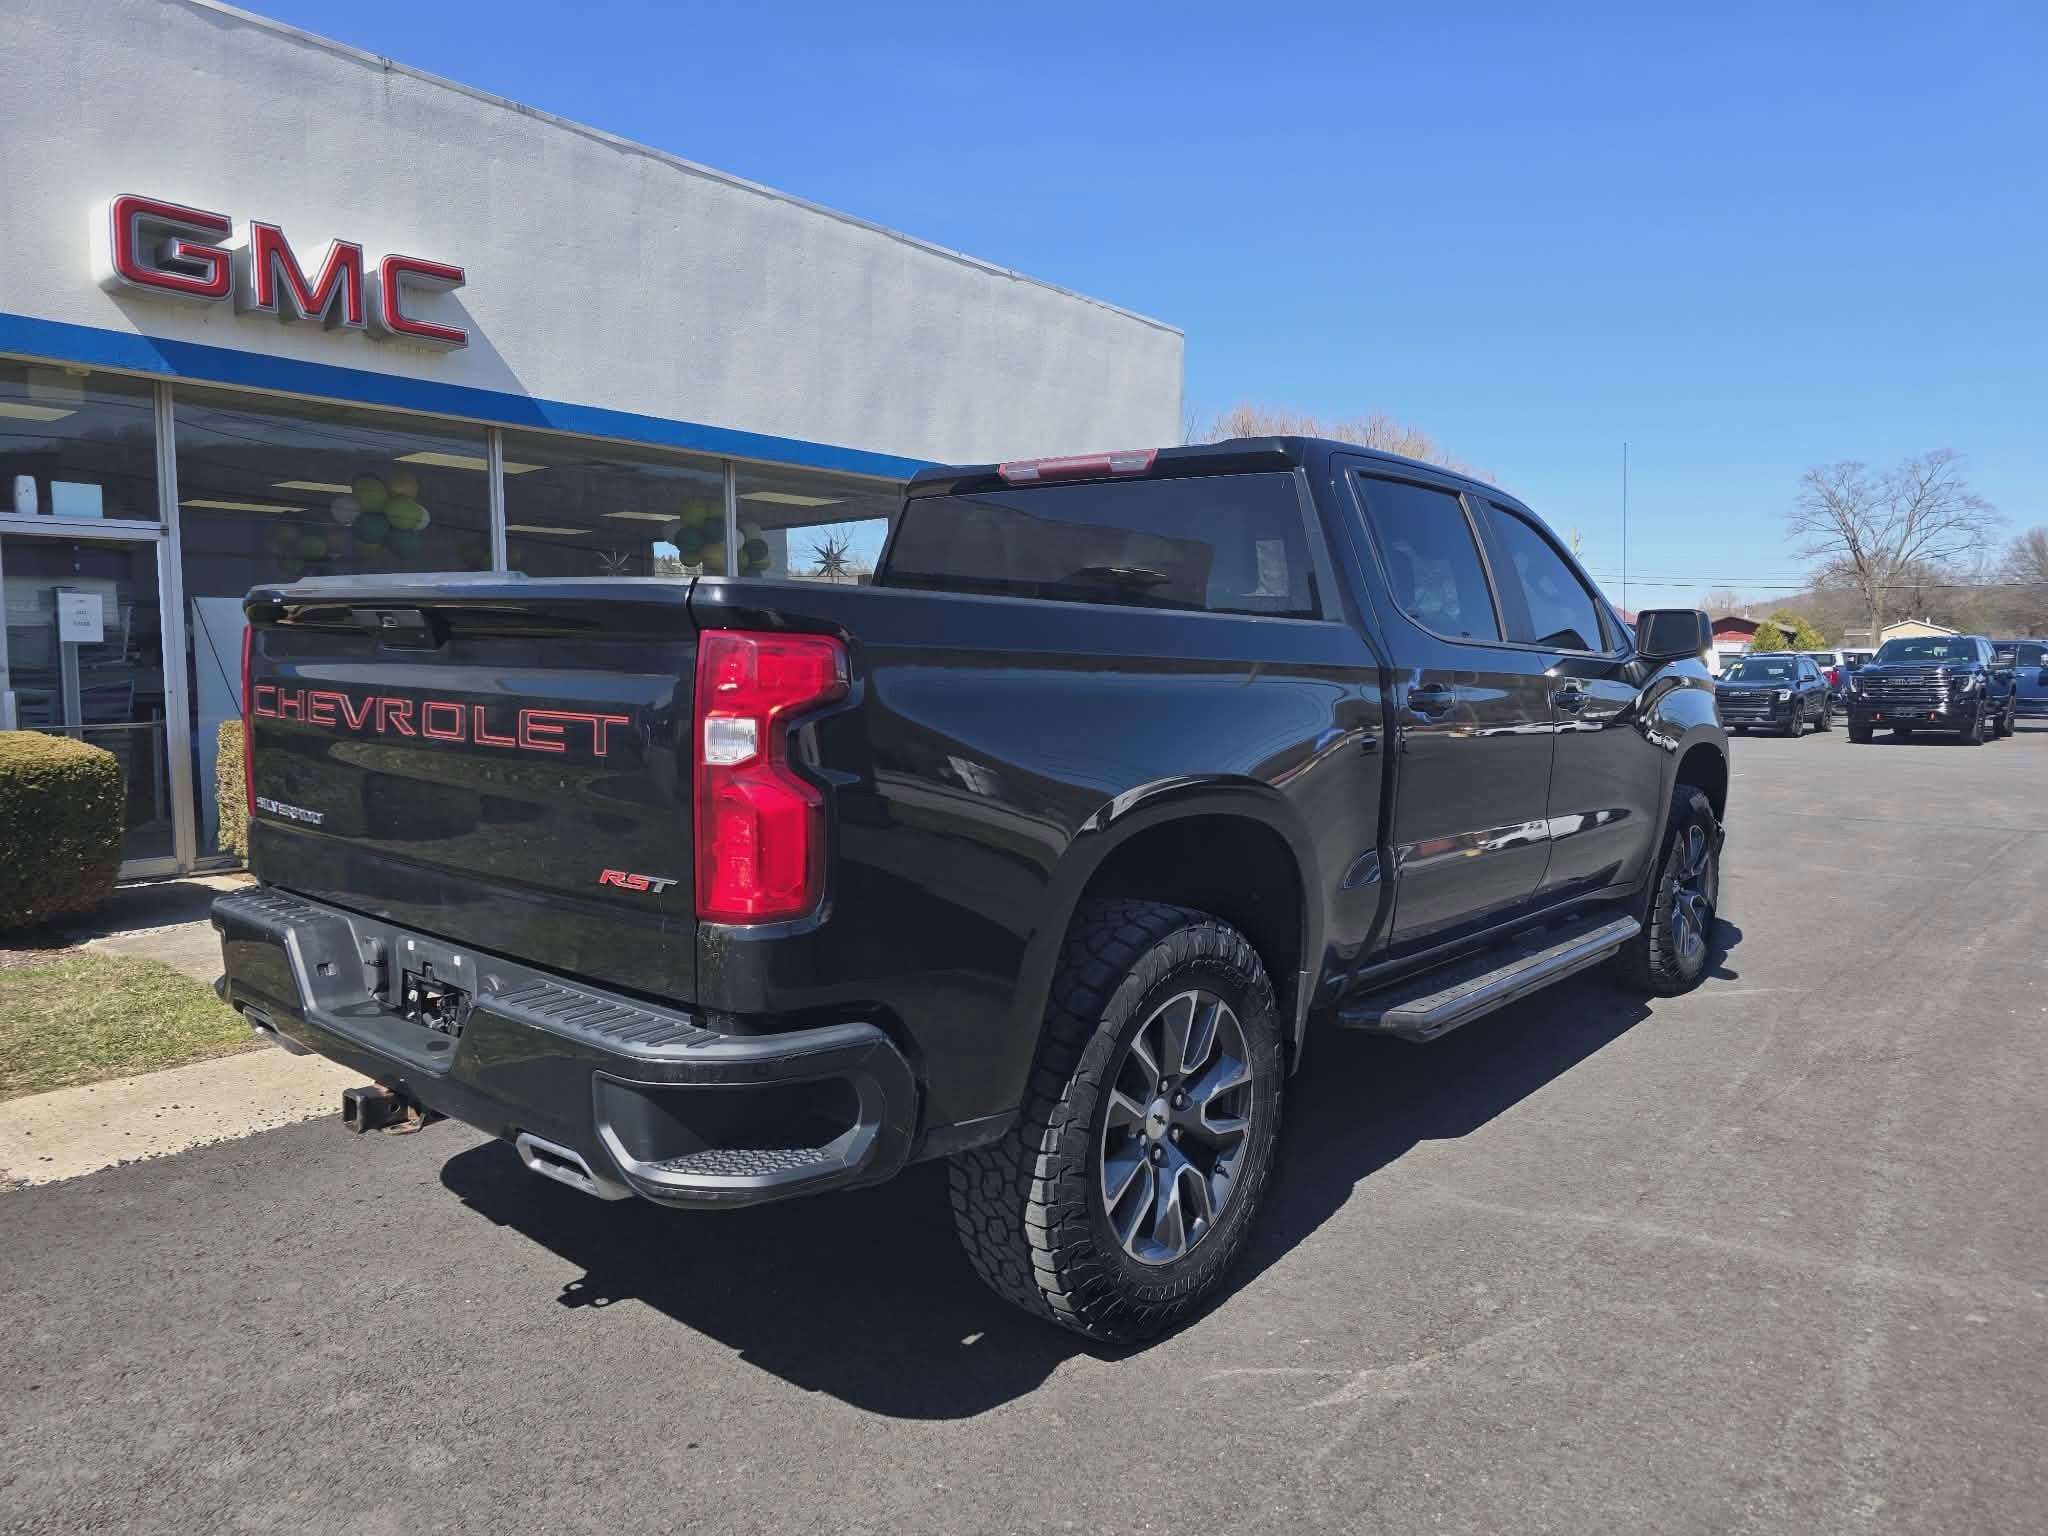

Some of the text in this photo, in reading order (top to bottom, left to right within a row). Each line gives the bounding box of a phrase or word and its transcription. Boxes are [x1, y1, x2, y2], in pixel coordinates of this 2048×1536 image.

[110, 193, 468, 348] GMC
[254, 685, 630, 756] CHEVROLET
[600, 869, 679, 893] RST
